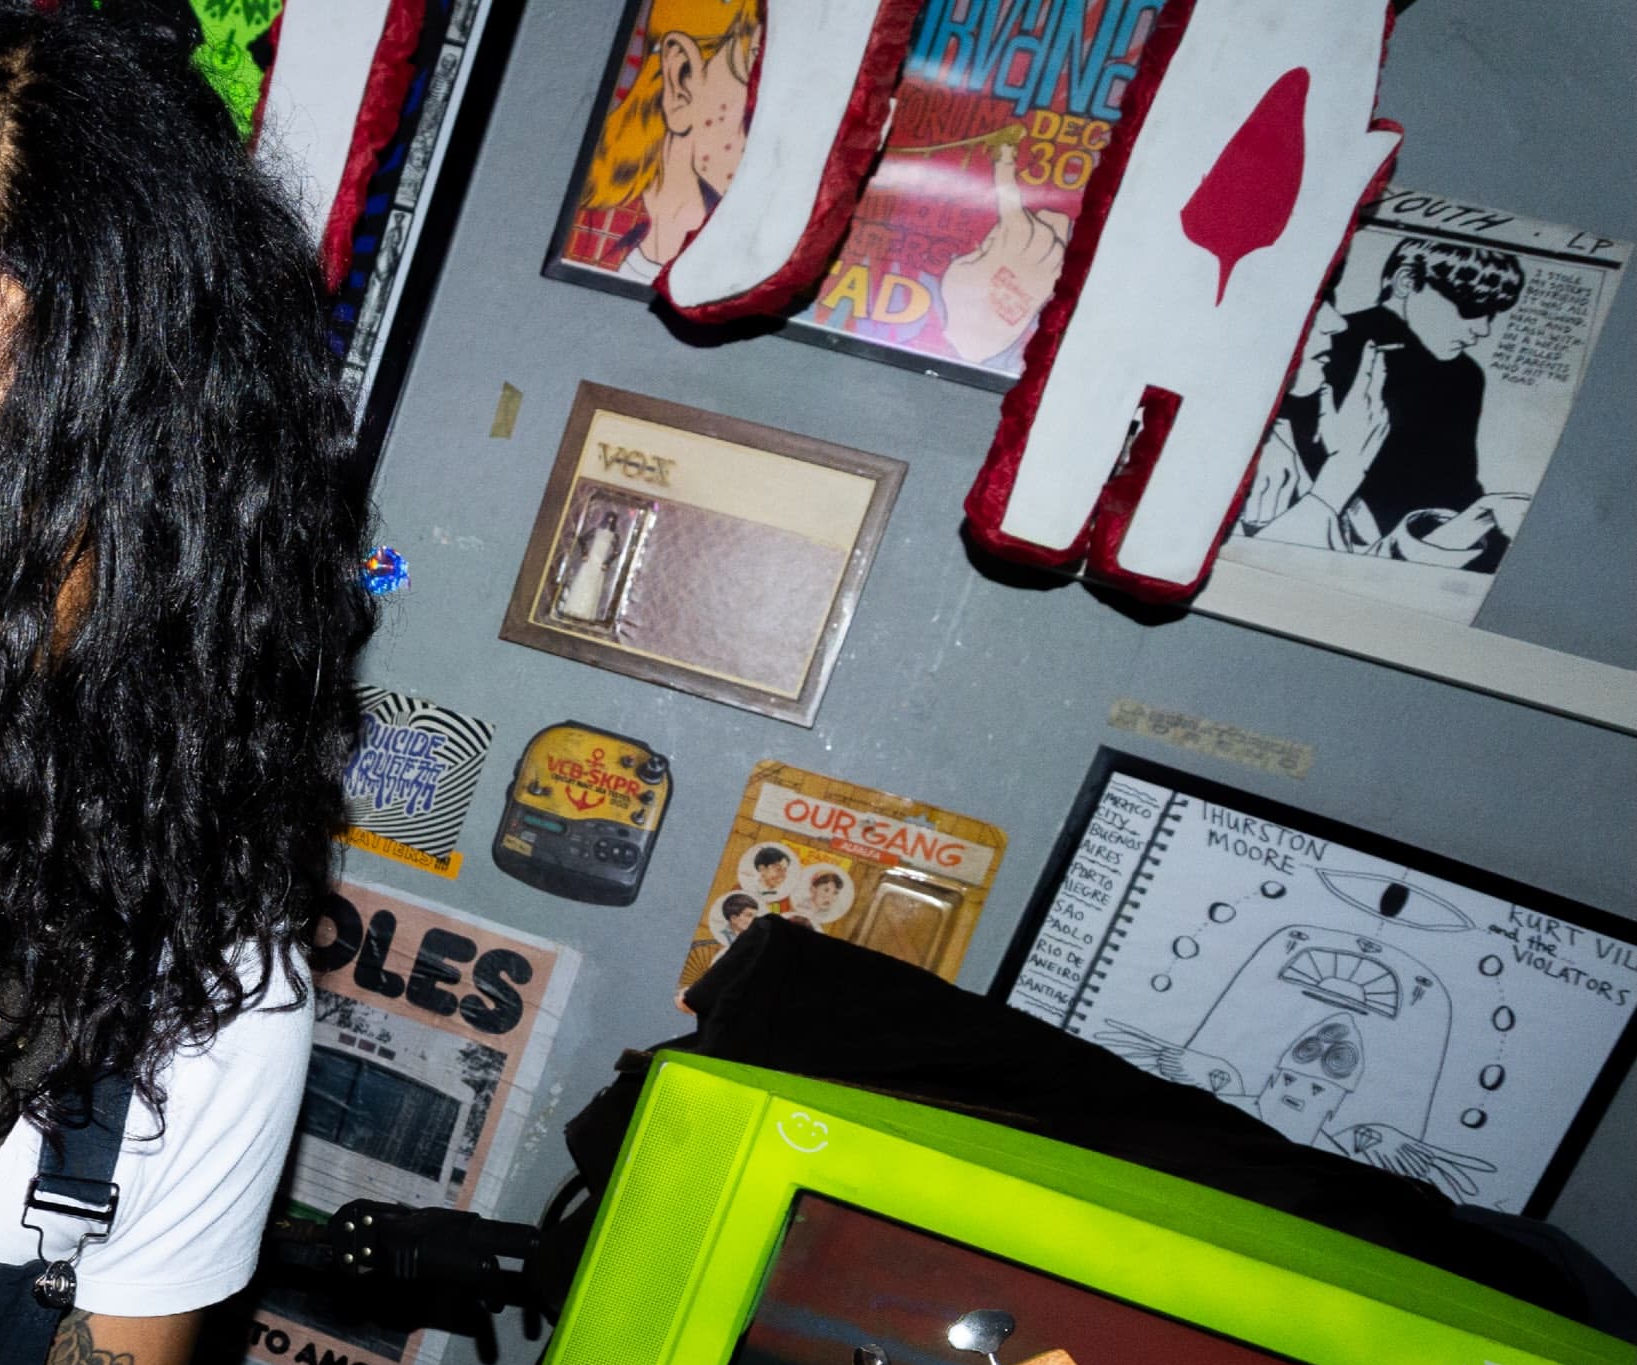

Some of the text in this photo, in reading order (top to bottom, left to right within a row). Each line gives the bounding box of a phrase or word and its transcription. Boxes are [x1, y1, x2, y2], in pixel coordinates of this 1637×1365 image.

[1031, 109, 1112, 150] DEC
[1020, 142, 1093, 191] 30
[1381, 188, 1614, 255] YOUTH LP
[821, 258, 931, 324] AD
[783, 798, 856, 840] OUR
[861, 820, 968, 868] GANG
[1201, 798, 1331, 862] THURSTON
[1207, 828, 1296, 876] MOORE
[1508, 903, 1586, 947] KURT
[1527, 934, 1558, 959] the
[1512, 944, 1632, 1007] VIOLATORS
